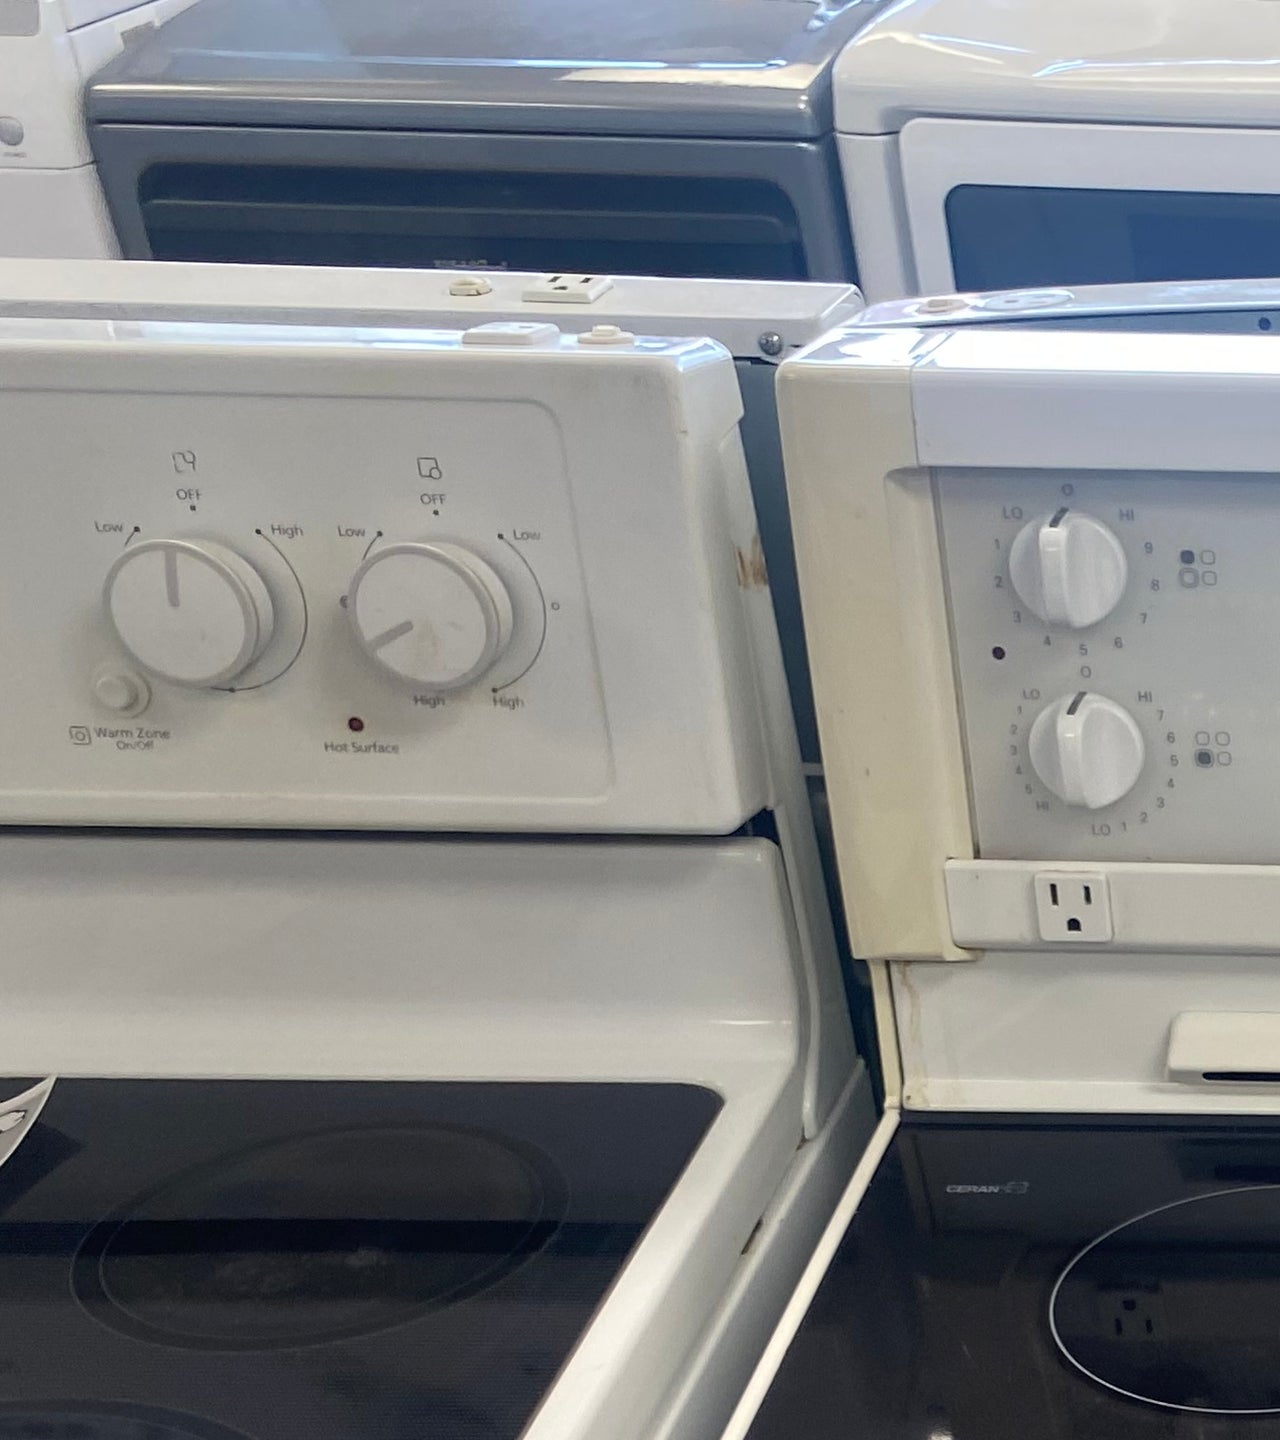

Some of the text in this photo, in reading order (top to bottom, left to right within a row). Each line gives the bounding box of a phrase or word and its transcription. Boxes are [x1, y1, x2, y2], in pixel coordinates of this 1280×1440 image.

[420, 493, 447, 505] OFF
[1002, 506, 1023, 520] LO
[1118, 508, 1135, 522] HI
[94, 520, 124, 533] Low
[271, 523, 304, 539] High
[337, 525, 366, 537] Low
[512, 528, 541, 541] Low
[1143, 541, 1154, 555] 9
[993, 575, 1004, 588] 2
[1012, 610, 1022, 624] 3
[1139, 612, 1148, 625] 7
[1043, 635, 1052, 646] 4
[1113, 636, 1124, 649] 6
[1079, 643, 1089, 656] 5
[1022, 688, 1041, 700] LO
[1137, 690, 1153, 703] HI
[413, 695, 446, 709] High
[492, 696, 525, 710] High
[1156, 709, 1165, 722] 7
[95, 727, 171, 740] Warm Zone
[1010, 724, 1018, 735] 2
[1166, 731, 1176, 744] 6
[324, 741, 400, 754] Hot Surface
[1169, 754, 1179, 767] 5
[1015, 765, 1023, 775] 4
[1167, 777, 1175, 789] 4
[1036, 801, 1049, 812] HI
[1156, 796, 1166, 809] 3
[1139, 811, 1149, 824] 2
[1091, 823, 1112, 837] LO
[946, 1184, 1000, 1194] CERAN
